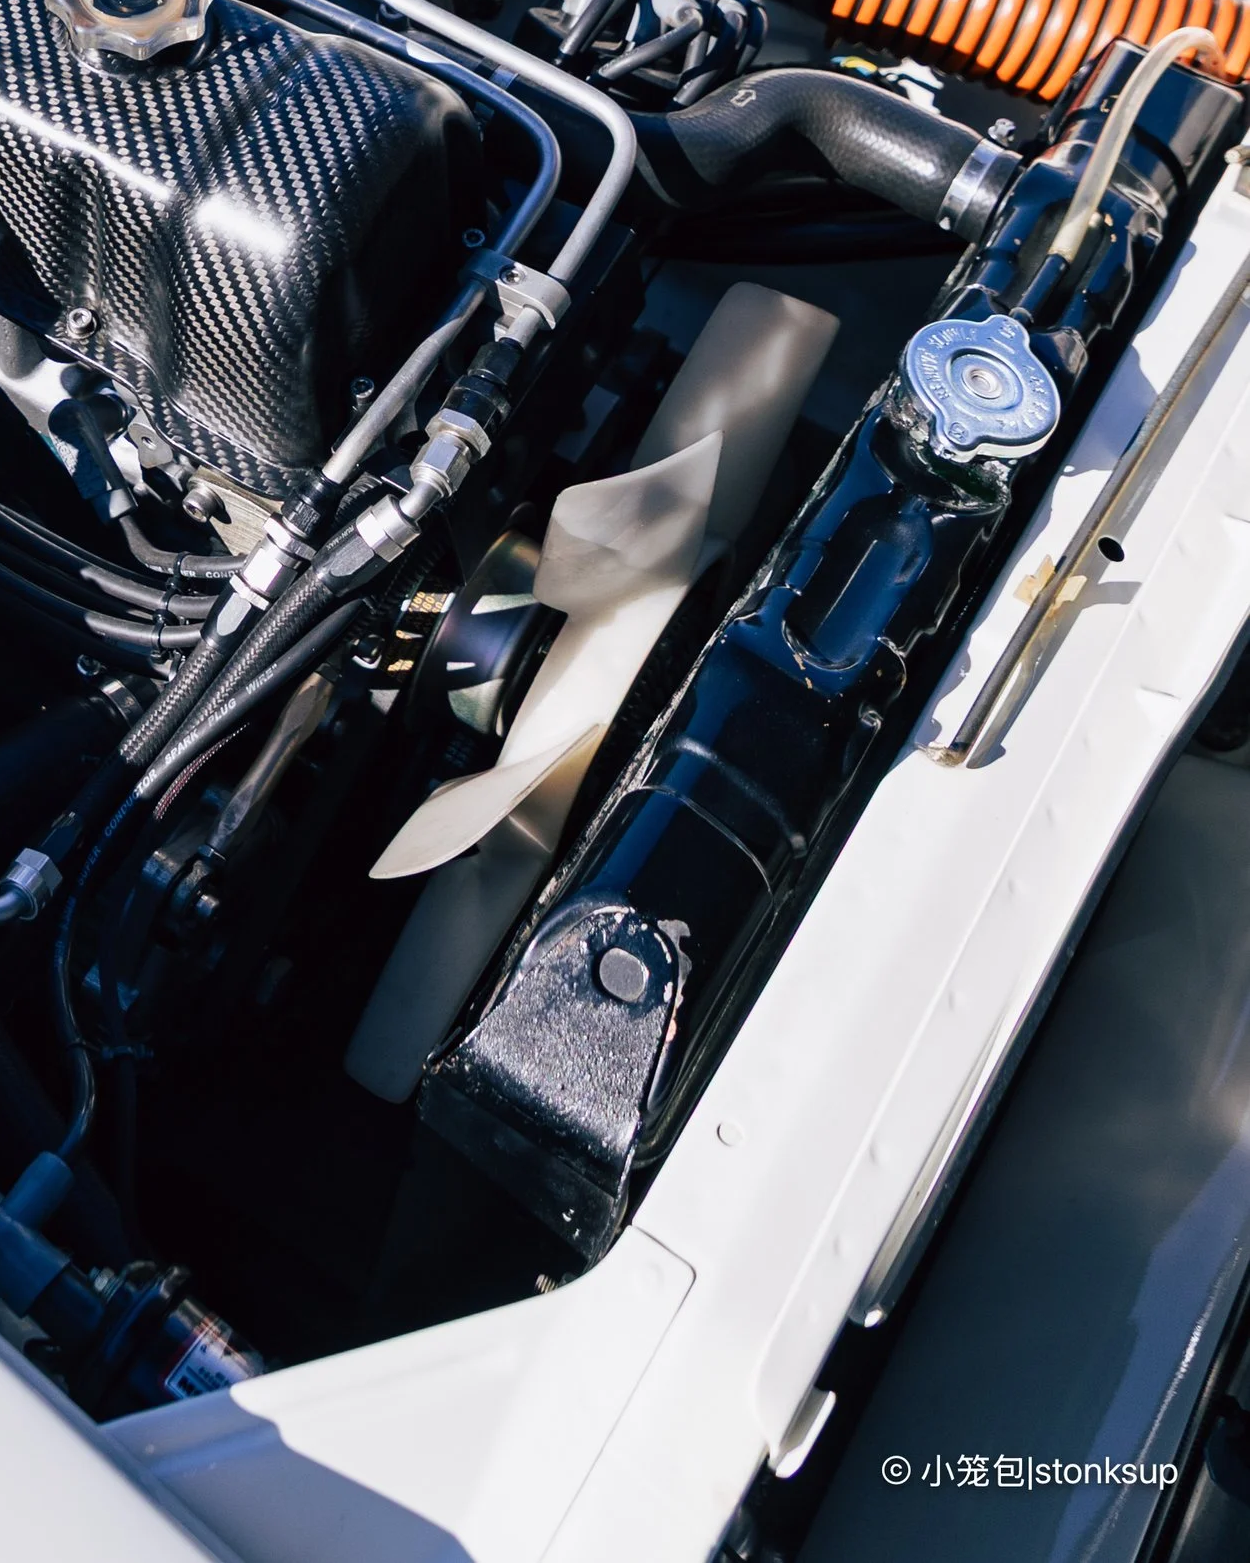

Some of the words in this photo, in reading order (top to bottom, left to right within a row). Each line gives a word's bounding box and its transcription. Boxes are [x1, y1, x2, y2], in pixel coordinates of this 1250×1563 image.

[104, 768, 158, 839] CONDUCTOR
[164, 728, 200, 766] SPARK
[207, 697, 238, 728] PLUG
